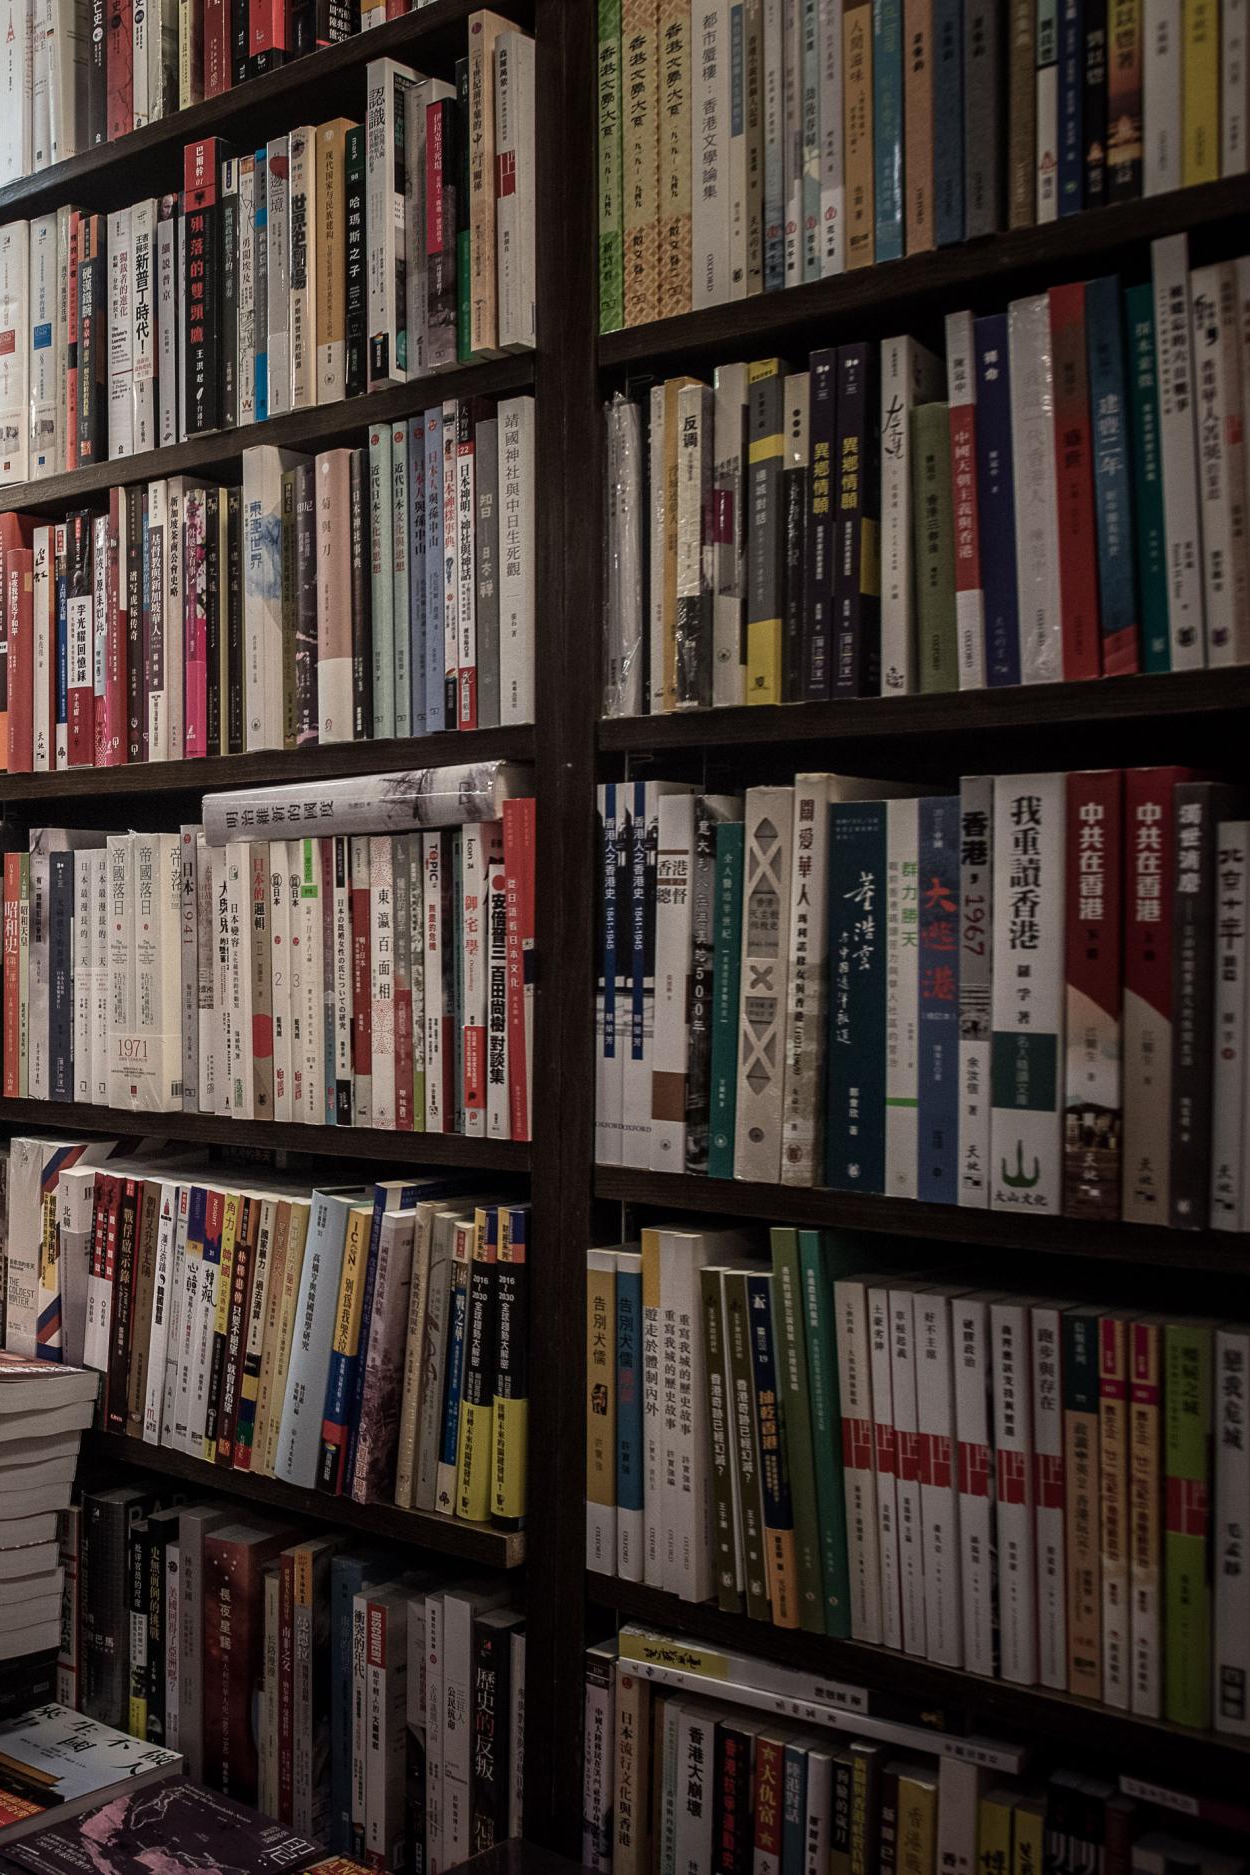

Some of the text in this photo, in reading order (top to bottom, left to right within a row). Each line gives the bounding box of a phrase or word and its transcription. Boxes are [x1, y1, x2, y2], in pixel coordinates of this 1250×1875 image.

[369, 87, 386, 129] 認識
[349, 197, 360, 278] 哈瑪斯之子
[119, 252, 129, 317] 獨裁者的進化
[135, 253, 150, 355] 新普丁時代！
[683, 415, 698, 449] 反调
[249, 501, 263, 570] 東亞世界
[371, 465, 382, 574] 近代日本文化與思想
[394, 463, 405, 573] 近代日本文化與思想
[428, 453, 438, 548] 日本人與孫中山
[504, 414, 521, 577] 靖國神社與中日生死觀
[954, 431, 974, 559] 中國天朝主義與香港
[150, 534, 162, 636] 基督教與新加坡華人
[169, 496, 179, 597] 新加坡茶商公會史略
[76, 604, 87, 682] 李光耀回憶錄
[226, 799, 333, 830] 明治維新的國度
[797, 799, 814, 907] 關愛華人
[112, 848, 126, 916] 帝國落日
[139, 847, 152, 916] 帝國落日
[253, 858, 265, 931] 日本的邏輯
[605, 817, 616, 900] 香港人之香港史
[633, 817, 645, 900] 香港人之香港史
[1010, 795, 1042, 950] 我重讀香港
[1078, 801, 1105, 921] 中共在香港
[1135, 802, 1163, 922] 中共在香港
[5, 901, 19, 955] 昭和史
[80, 862, 89, 967] 日本最漫長的一天
[98, 861, 106, 967] 日本最漫長的一天
[182, 862, 194, 944] 日本1941
[230, 903, 239, 947] 日本變容
[377, 888, 390, 999] 東瀛百面相
[465, 895, 478, 955] 御宅學
[507, 879, 519, 988] 從日語看日本文化
[901, 862, 918, 948] 群力勝天
[489, 893, 506, 1084] 安倍晉三 百田尚樹 對談集
[118, 1038, 148, 1058] 1971
[9, 1277, 19, 1287] THE
[9, 1286, 35, 1297] COLDEST
[593, 1296, 607, 1367] 告別犬儒
[619, 1297, 633, 1369] 告別犬儒
[644, 1307, 659, 1419] 遊走於體制內外
[663, 1309, 677, 1430] 重寫我城的歷史故事
[679, 1314, 692, 1436] 重寫我城的歷史故事
[353, 1609, 365, 1680] 衝突的年代
[370, 1611, 382, 1665] DISCOVERY
[447, 1685, 456, 1731] 公民抗命
[476, 1667, 496, 1782] 歷史的反叛
[619, 1711, 632, 1847] 日本流行文化與香港
[687, 1726, 704, 1818] 香港大崩壞
[758, 1765, 777, 1827] 大仇富
